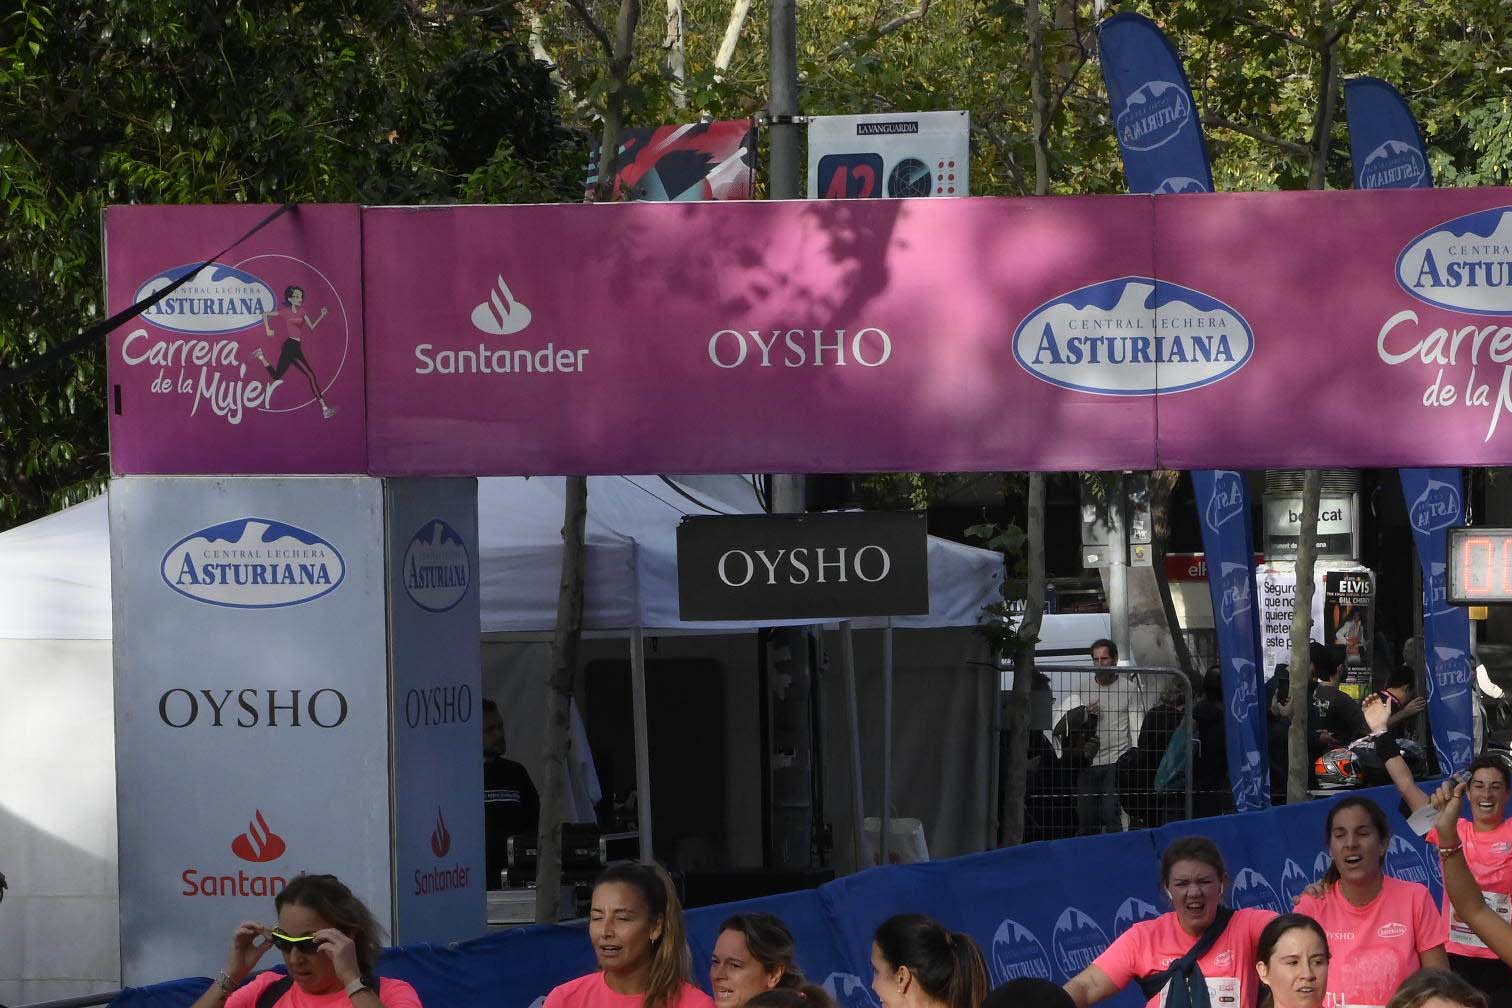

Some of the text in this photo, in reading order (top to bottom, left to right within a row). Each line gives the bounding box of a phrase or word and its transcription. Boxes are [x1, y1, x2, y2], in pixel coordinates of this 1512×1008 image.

[867, 122, 917, 134] VANGUARDIA
[1068, 316, 1227, 331] CENTRAL LECHERA
[122, 328, 240, 366] Carrera
[415, 344, 590, 375] Santander
[708, 328, 892, 369] OYSHO
[1031, 321, 1235, 365] ASTURIANA
[151, 364, 284, 425] de la Mujer
[1422, 368, 1457, 407] de
[1465, 367, 1489, 407] la
[175, 551, 331, 586] ASTURIANA
[204, 549, 325, 558] CENTRAL LECHERA
[408, 554, 466, 589] ASTURIANA
[717, 545, 891, 587] OYSHO
[1340, 581, 1370, 594] ELVIS
[158, 688, 348, 728] OYSHO
[405, 684, 473, 730] OYSHO
[414, 864, 471, 896] Santander
